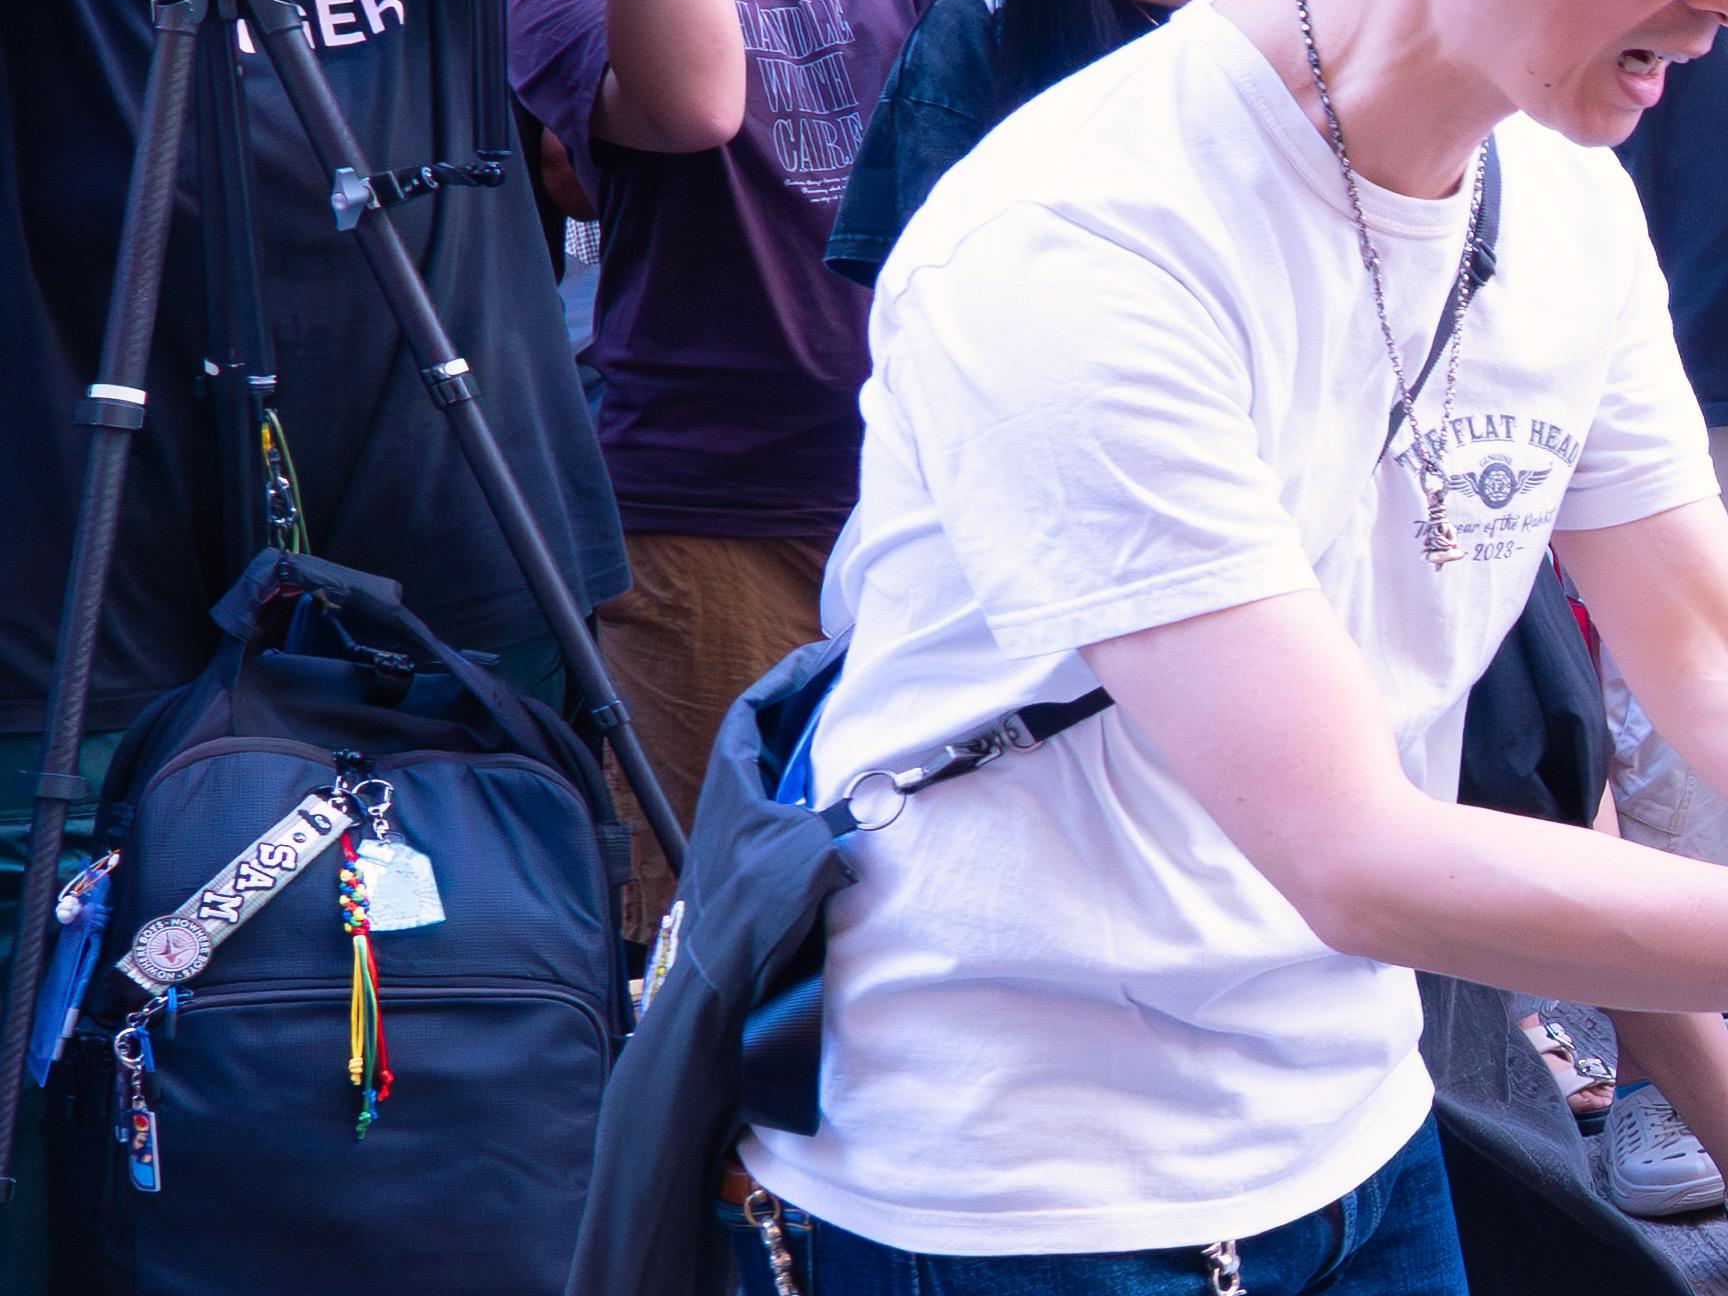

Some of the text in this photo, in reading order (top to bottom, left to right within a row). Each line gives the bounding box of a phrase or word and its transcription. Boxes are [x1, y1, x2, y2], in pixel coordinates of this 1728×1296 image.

[756, 51, 860, 114] WITH
[772, 112, 865, 172] CARE
[1452, 414, 1519, 448] FLAT
[1499, 514, 1521, 533] the
[198, 842, 299, 924] SAM
